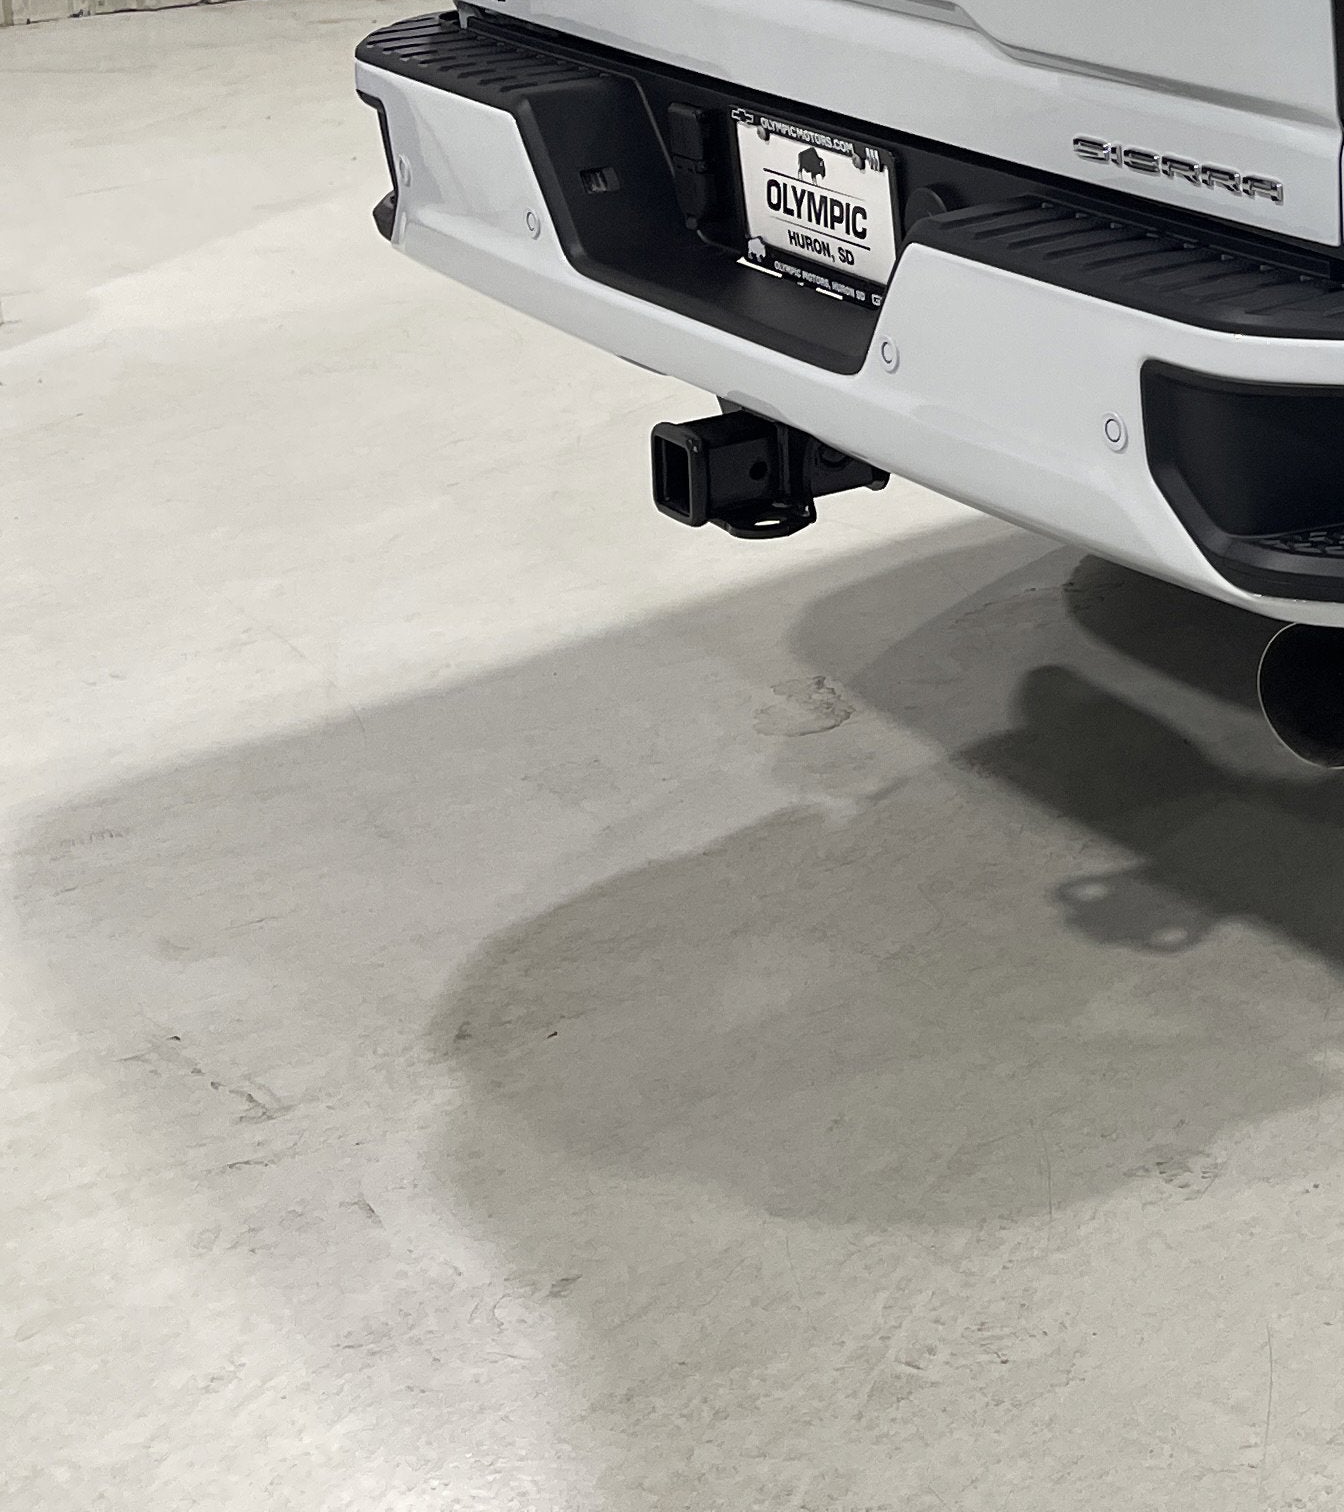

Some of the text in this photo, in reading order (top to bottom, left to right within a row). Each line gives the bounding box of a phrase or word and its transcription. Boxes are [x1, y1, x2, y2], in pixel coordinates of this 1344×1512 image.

[760, 117, 854, 154] OLYMPICMOTORS.COM
[1072, 136, 1284, 206] SIERRA
[766, 179, 868, 240] OLYMPIC
[788, 229, 855, 266] HURON, SD
